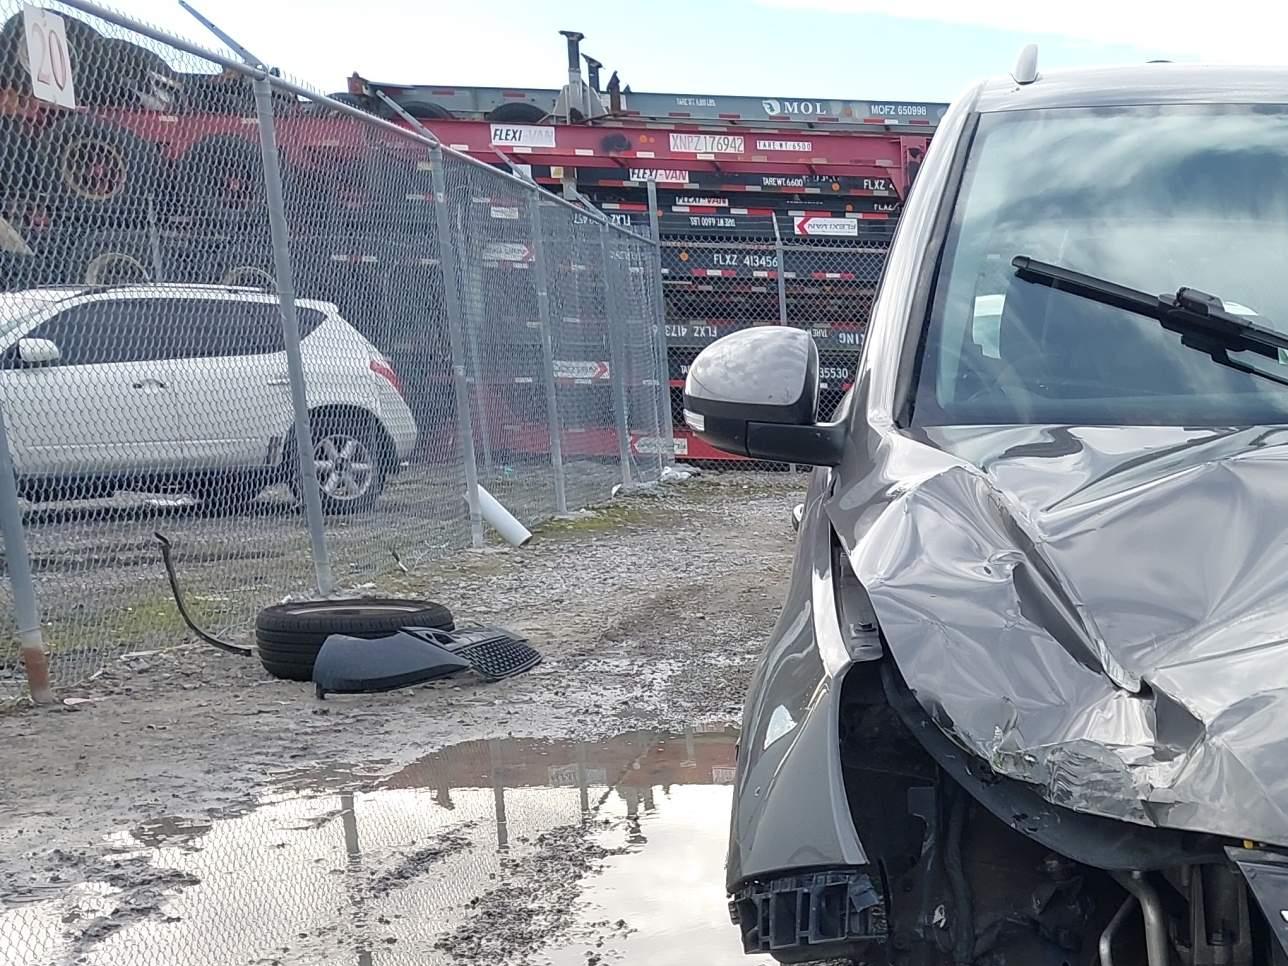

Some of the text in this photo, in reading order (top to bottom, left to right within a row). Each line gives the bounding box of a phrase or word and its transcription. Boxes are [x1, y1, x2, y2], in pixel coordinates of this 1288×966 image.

[784, 101, 826, 115] MOL
[871, 105, 895, 115] MOFZ
[493, 128, 522, 141] FLEXI
[864, 179, 886, 190] FLXZ
[713, 254, 738, 265] FLXZ
